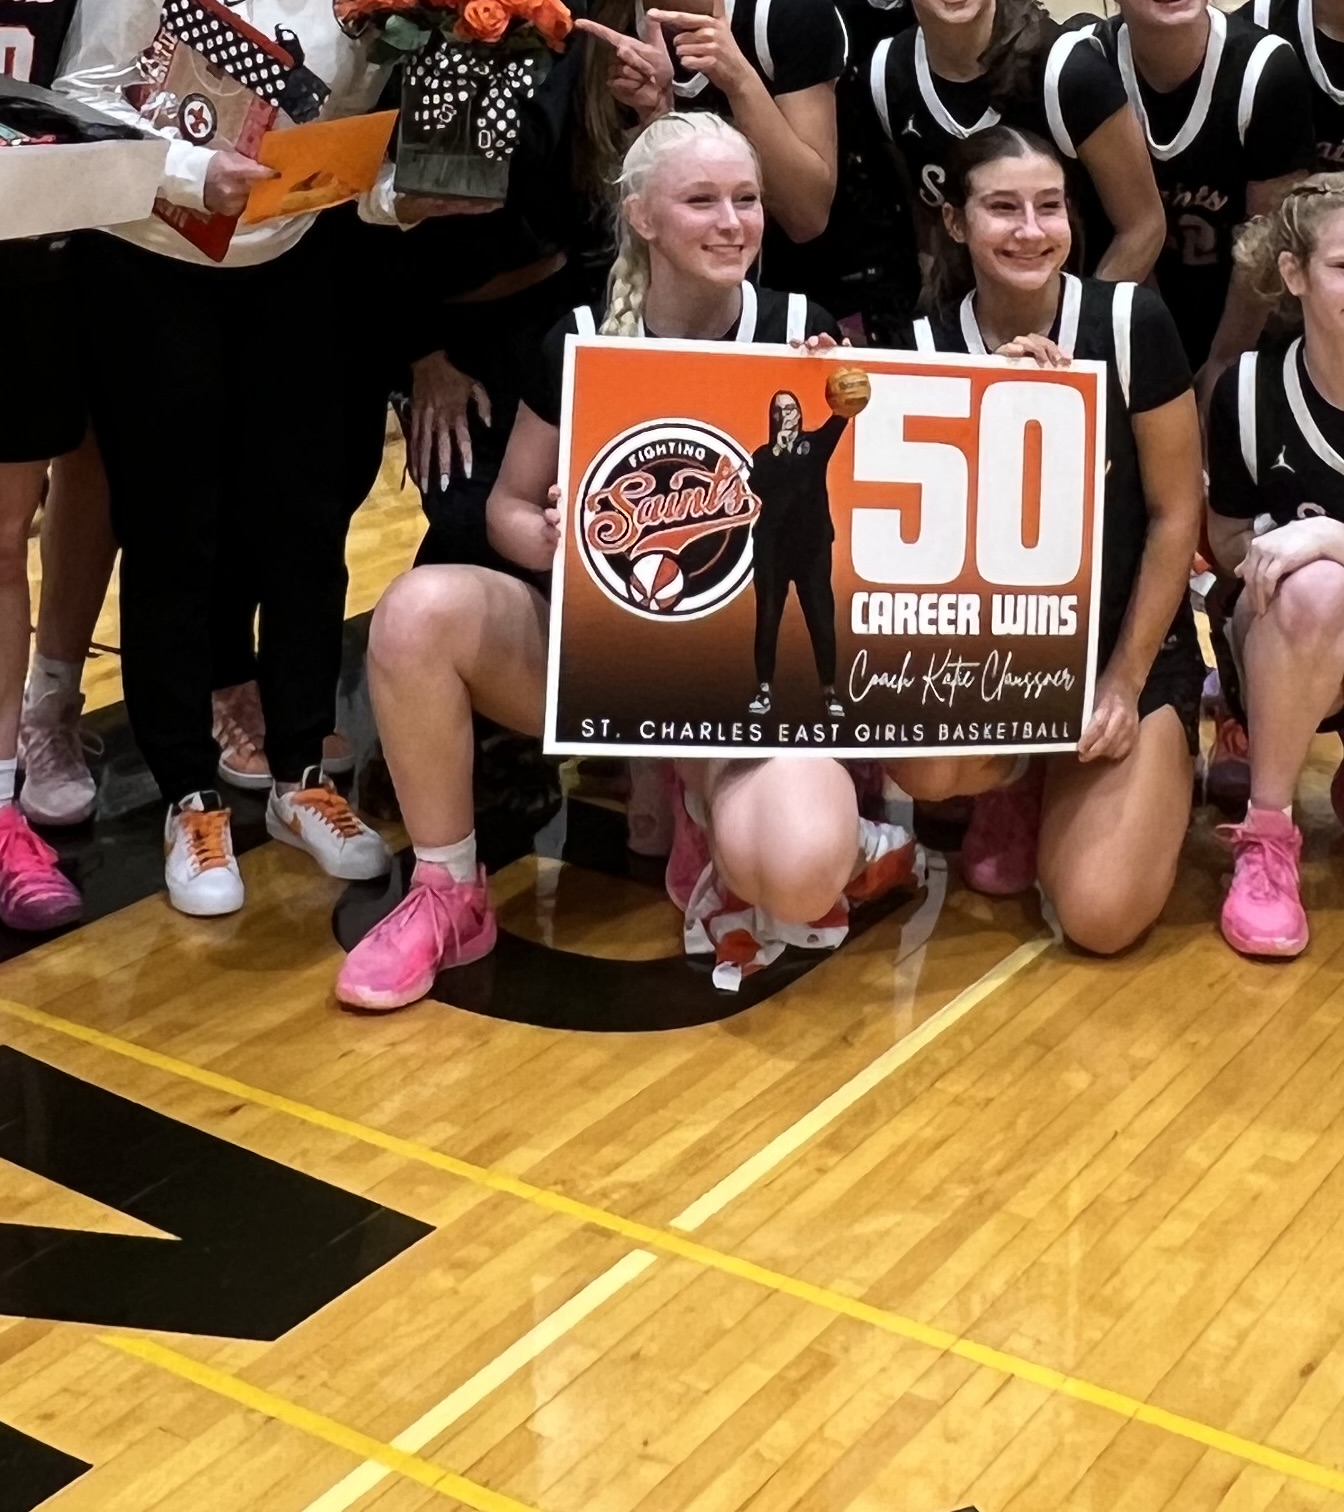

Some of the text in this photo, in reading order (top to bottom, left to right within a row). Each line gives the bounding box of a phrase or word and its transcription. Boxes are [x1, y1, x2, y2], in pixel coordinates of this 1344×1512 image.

[629, 442, 705, 468] FIGHTING
[851, 373, 1086, 586] 50
[585, 454, 761, 555] Saints
[851, 592, 1078, 635] CAREER WINS
[849, 649, 915, 702] Coach
[922, 649, 981, 708] Katie
[580, 719, 1069, 742] ST. CHARLES EAST GIRLS BASKETBALL
